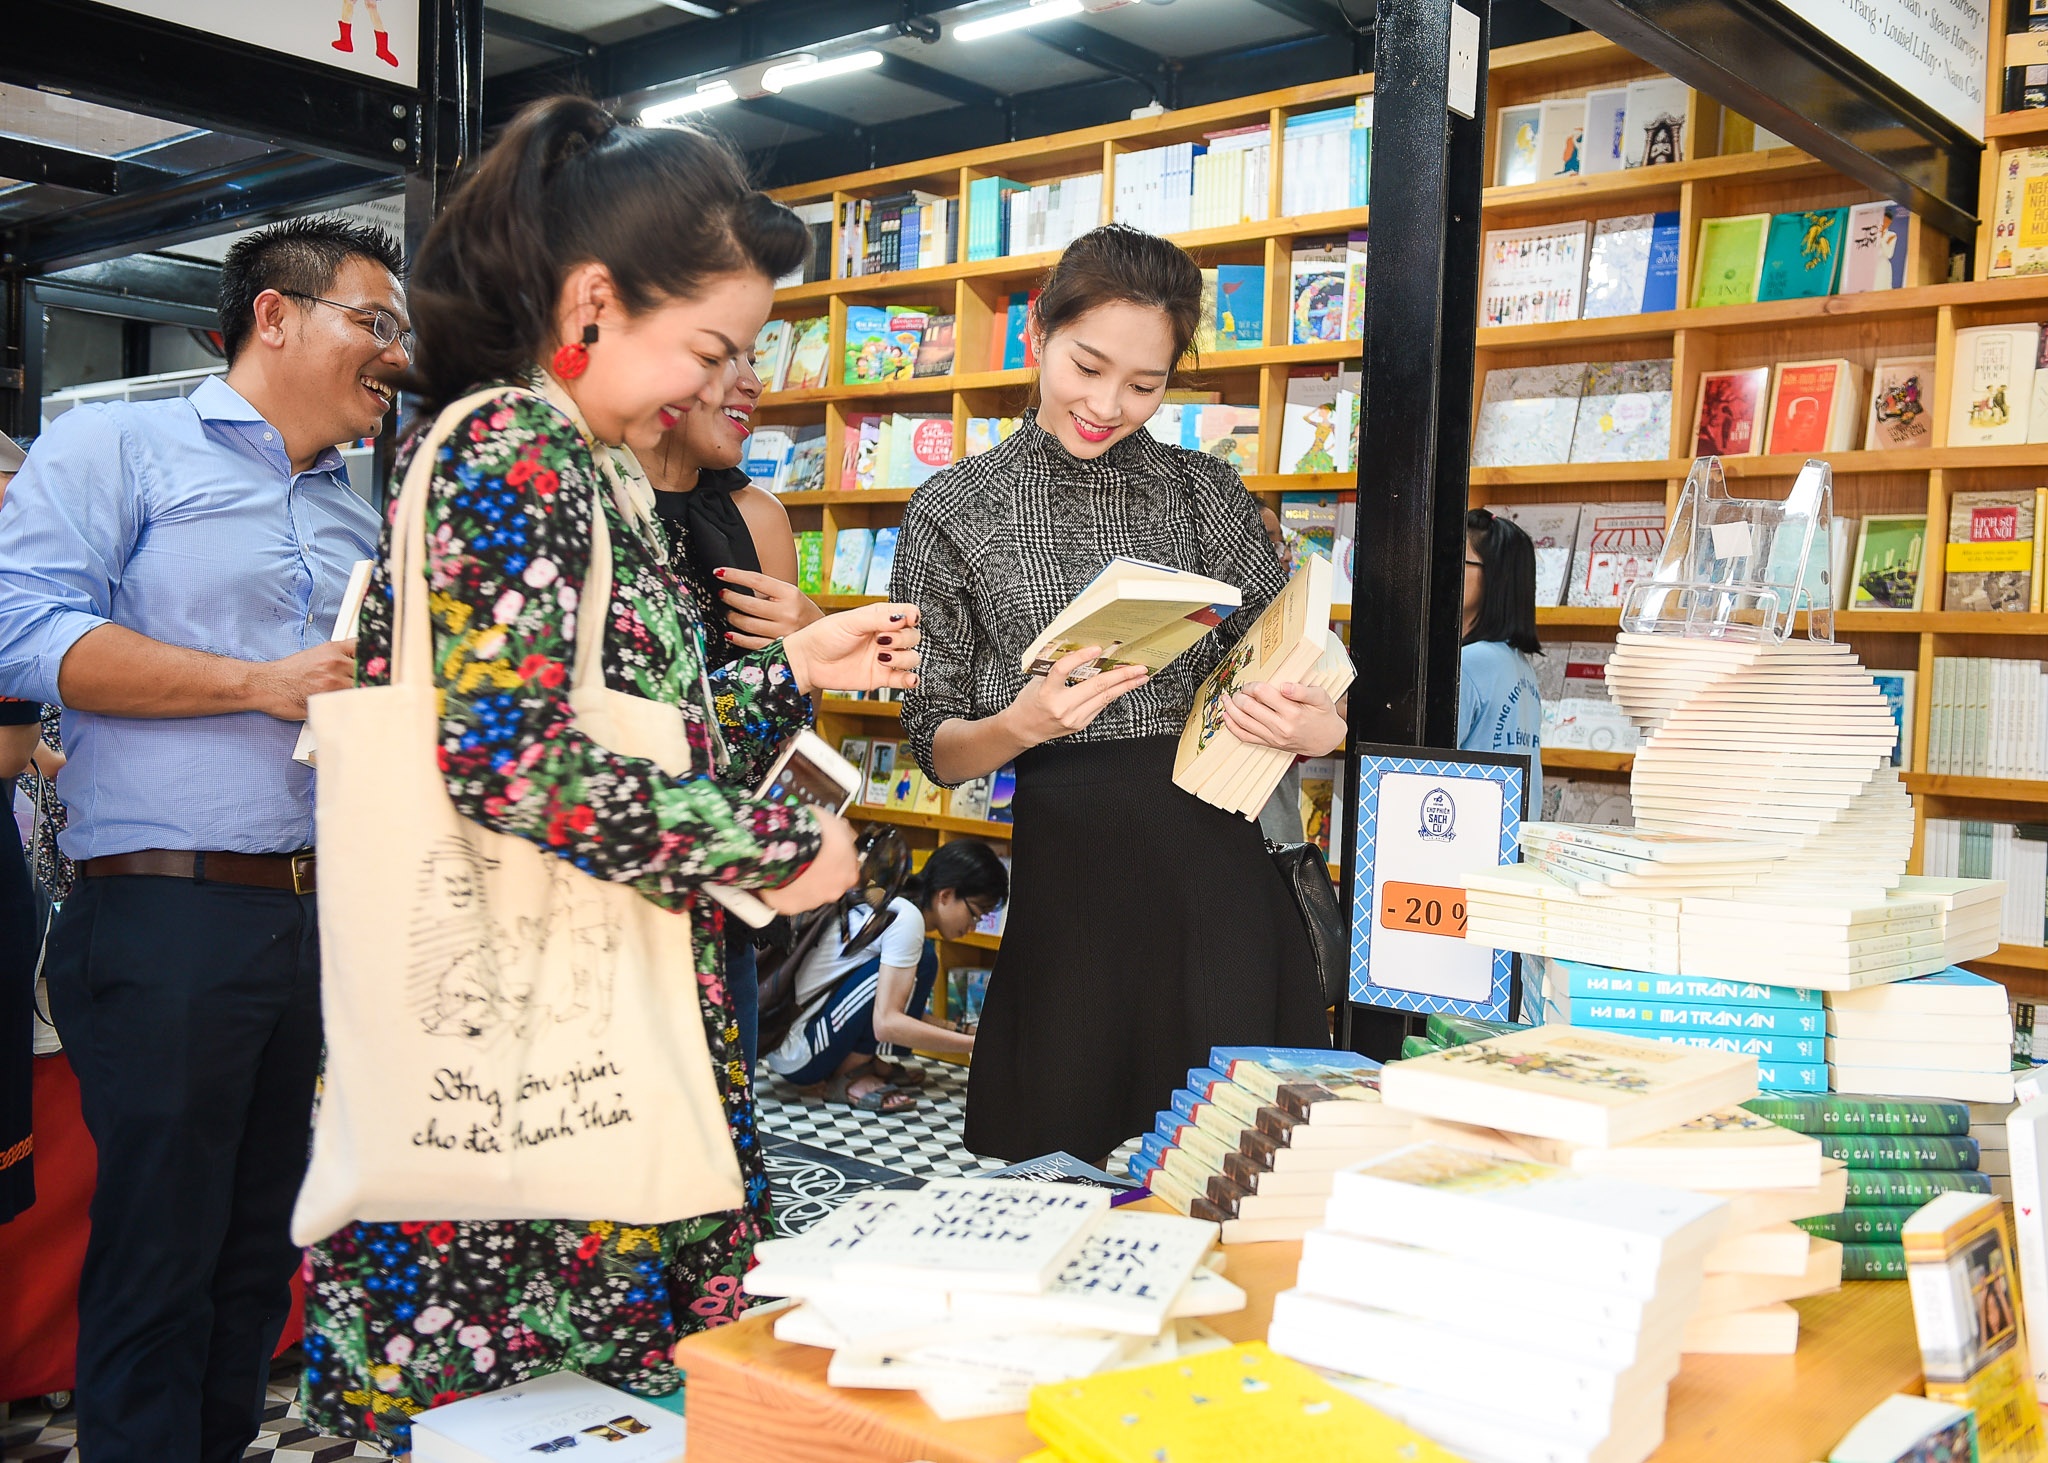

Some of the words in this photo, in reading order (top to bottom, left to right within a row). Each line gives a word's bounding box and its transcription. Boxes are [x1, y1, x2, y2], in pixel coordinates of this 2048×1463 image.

[1929, 8, 1951, 41] Steve
[1950, 25, 1979, 67] Harvey
[1966, 75, 1981, 103] Cao
[1493, 704, 1511, 750] TRUNG
[1405, 897, 1442, 927] 20
[412, 1117, 457, 1150] cho
[1008, 1157, 1073, 1181] HARUKI
[1801, 1223, 1836, 1231] AWKINS
